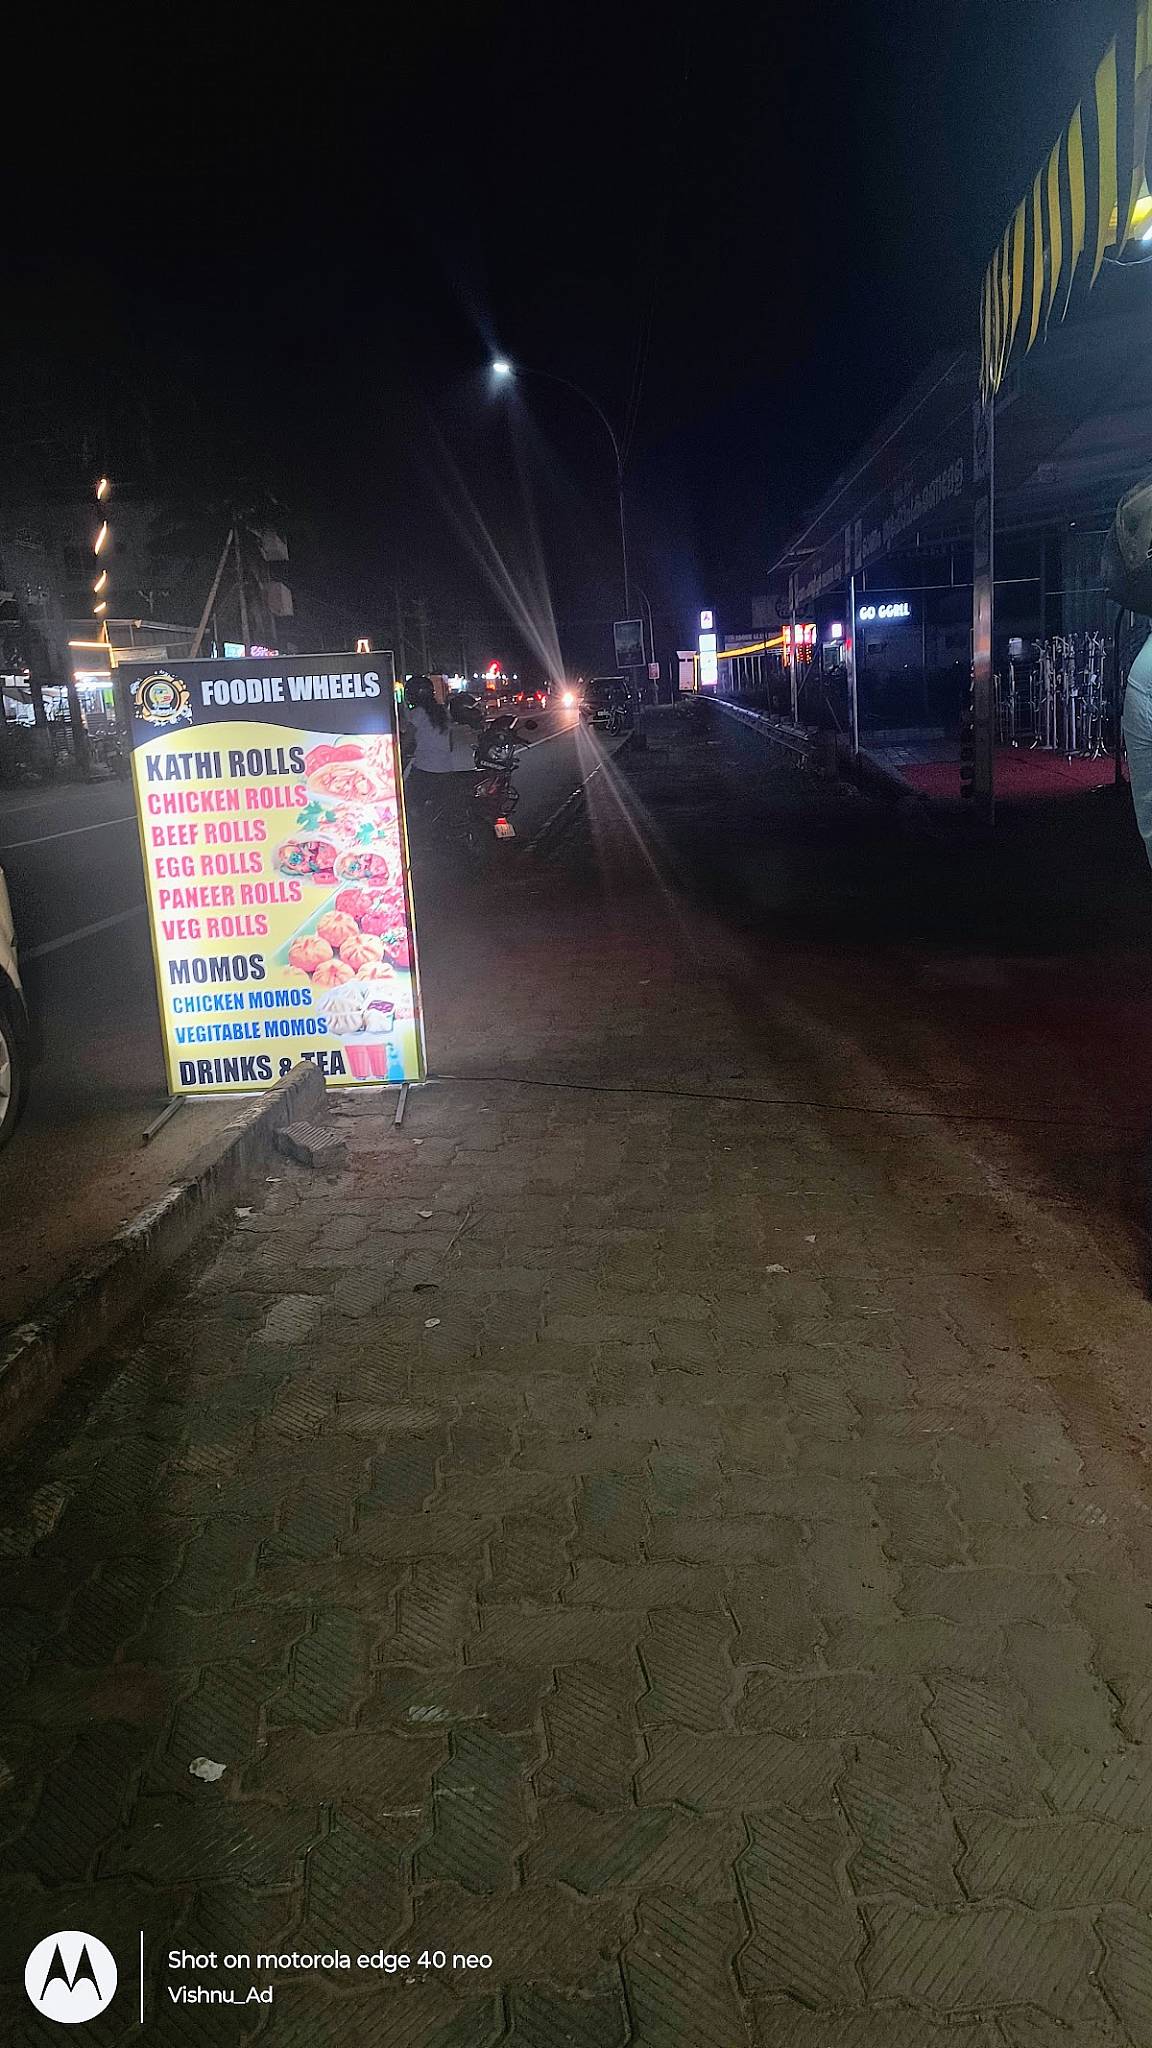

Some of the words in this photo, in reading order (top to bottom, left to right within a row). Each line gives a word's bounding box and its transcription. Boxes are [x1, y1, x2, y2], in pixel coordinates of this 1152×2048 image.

[200, 676, 285, 706] FOODIE
[288, 672, 380, 701] WHEELS
[146, 752, 222, 781] KATHI
[229, 746, 305, 777] ROLLS
[148, 791, 241, 815] CHICKEN
[245, 785, 308, 810] ROLLS
[151, 824, 201, 847] BEEF
[205, 820, 267, 844] ROLLS
[155, 855, 196, 878] EGG
[200, 852, 262, 875] ROLLS
[158, 884, 236, 909] PANEER
[240, 880, 302, 904] ROLLS
[162, 918, 201, 941] VEG
[205, 914, 268, 937] ROLLS
[169, 954, 266, 984] MOMOS
[173, 993, 245, 1014] CHICKEN
[248, 989, 312, 1009] MOMOS
[175, 1021, 261, 1044] VEGITABLE
[265, 1017, 327, 1038] MOMOS
[180, 1056, 273, 1086] DRINKS
